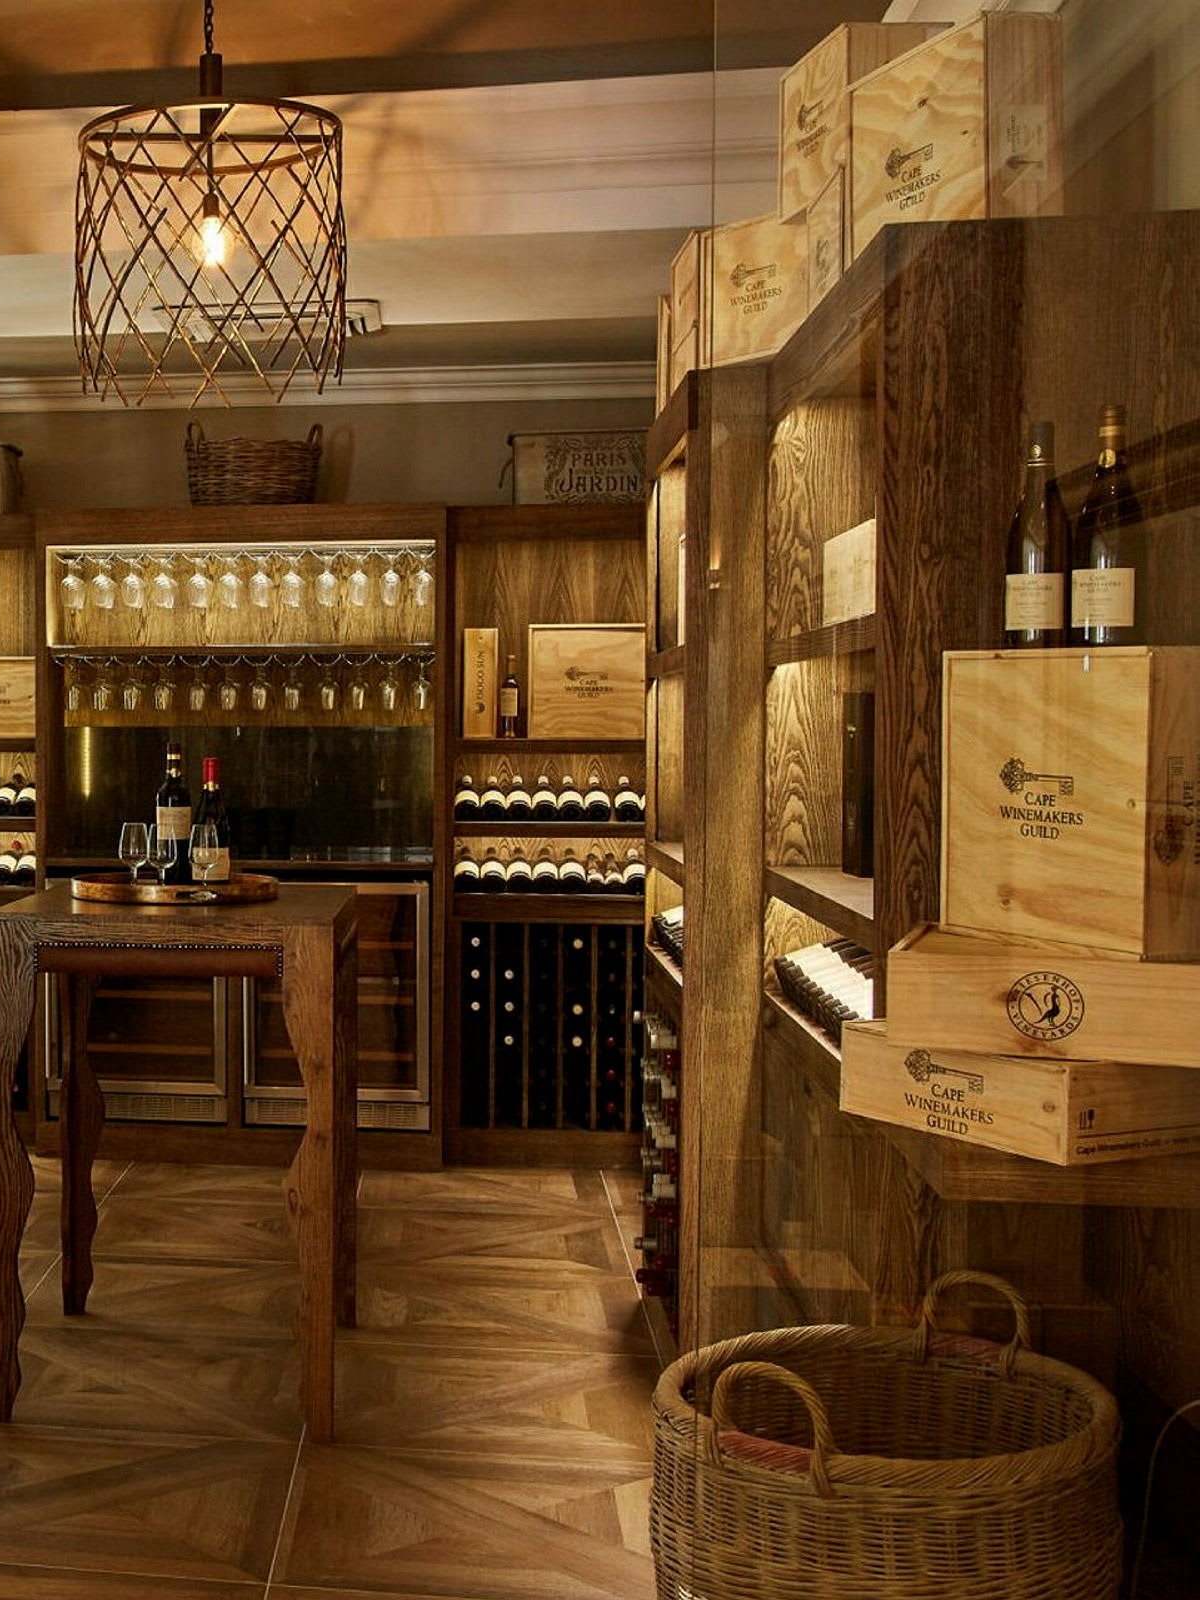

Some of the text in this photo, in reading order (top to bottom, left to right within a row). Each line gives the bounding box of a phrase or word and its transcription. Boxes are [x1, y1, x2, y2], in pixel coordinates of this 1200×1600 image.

[901, 165, 922, 183] CAPE
[885, 169, 941, 203] WINEMAKERS
[899, 190, 926, 211] GUILD
[571, 452, 627, 468] PARIS
[559, 468, 639, 493] JARDIN
[1024, 791, 1056, 808] CAPE
[999, 806, 1083, 825] WINEMAKERS
[1019, 823, 1060, 840] GUILD
[930, 1083, 965, 1103] CAPE
[904, 1092, 994, 1125] WINEMAKERS
[926, 1114, 969, 1135] GUILD
